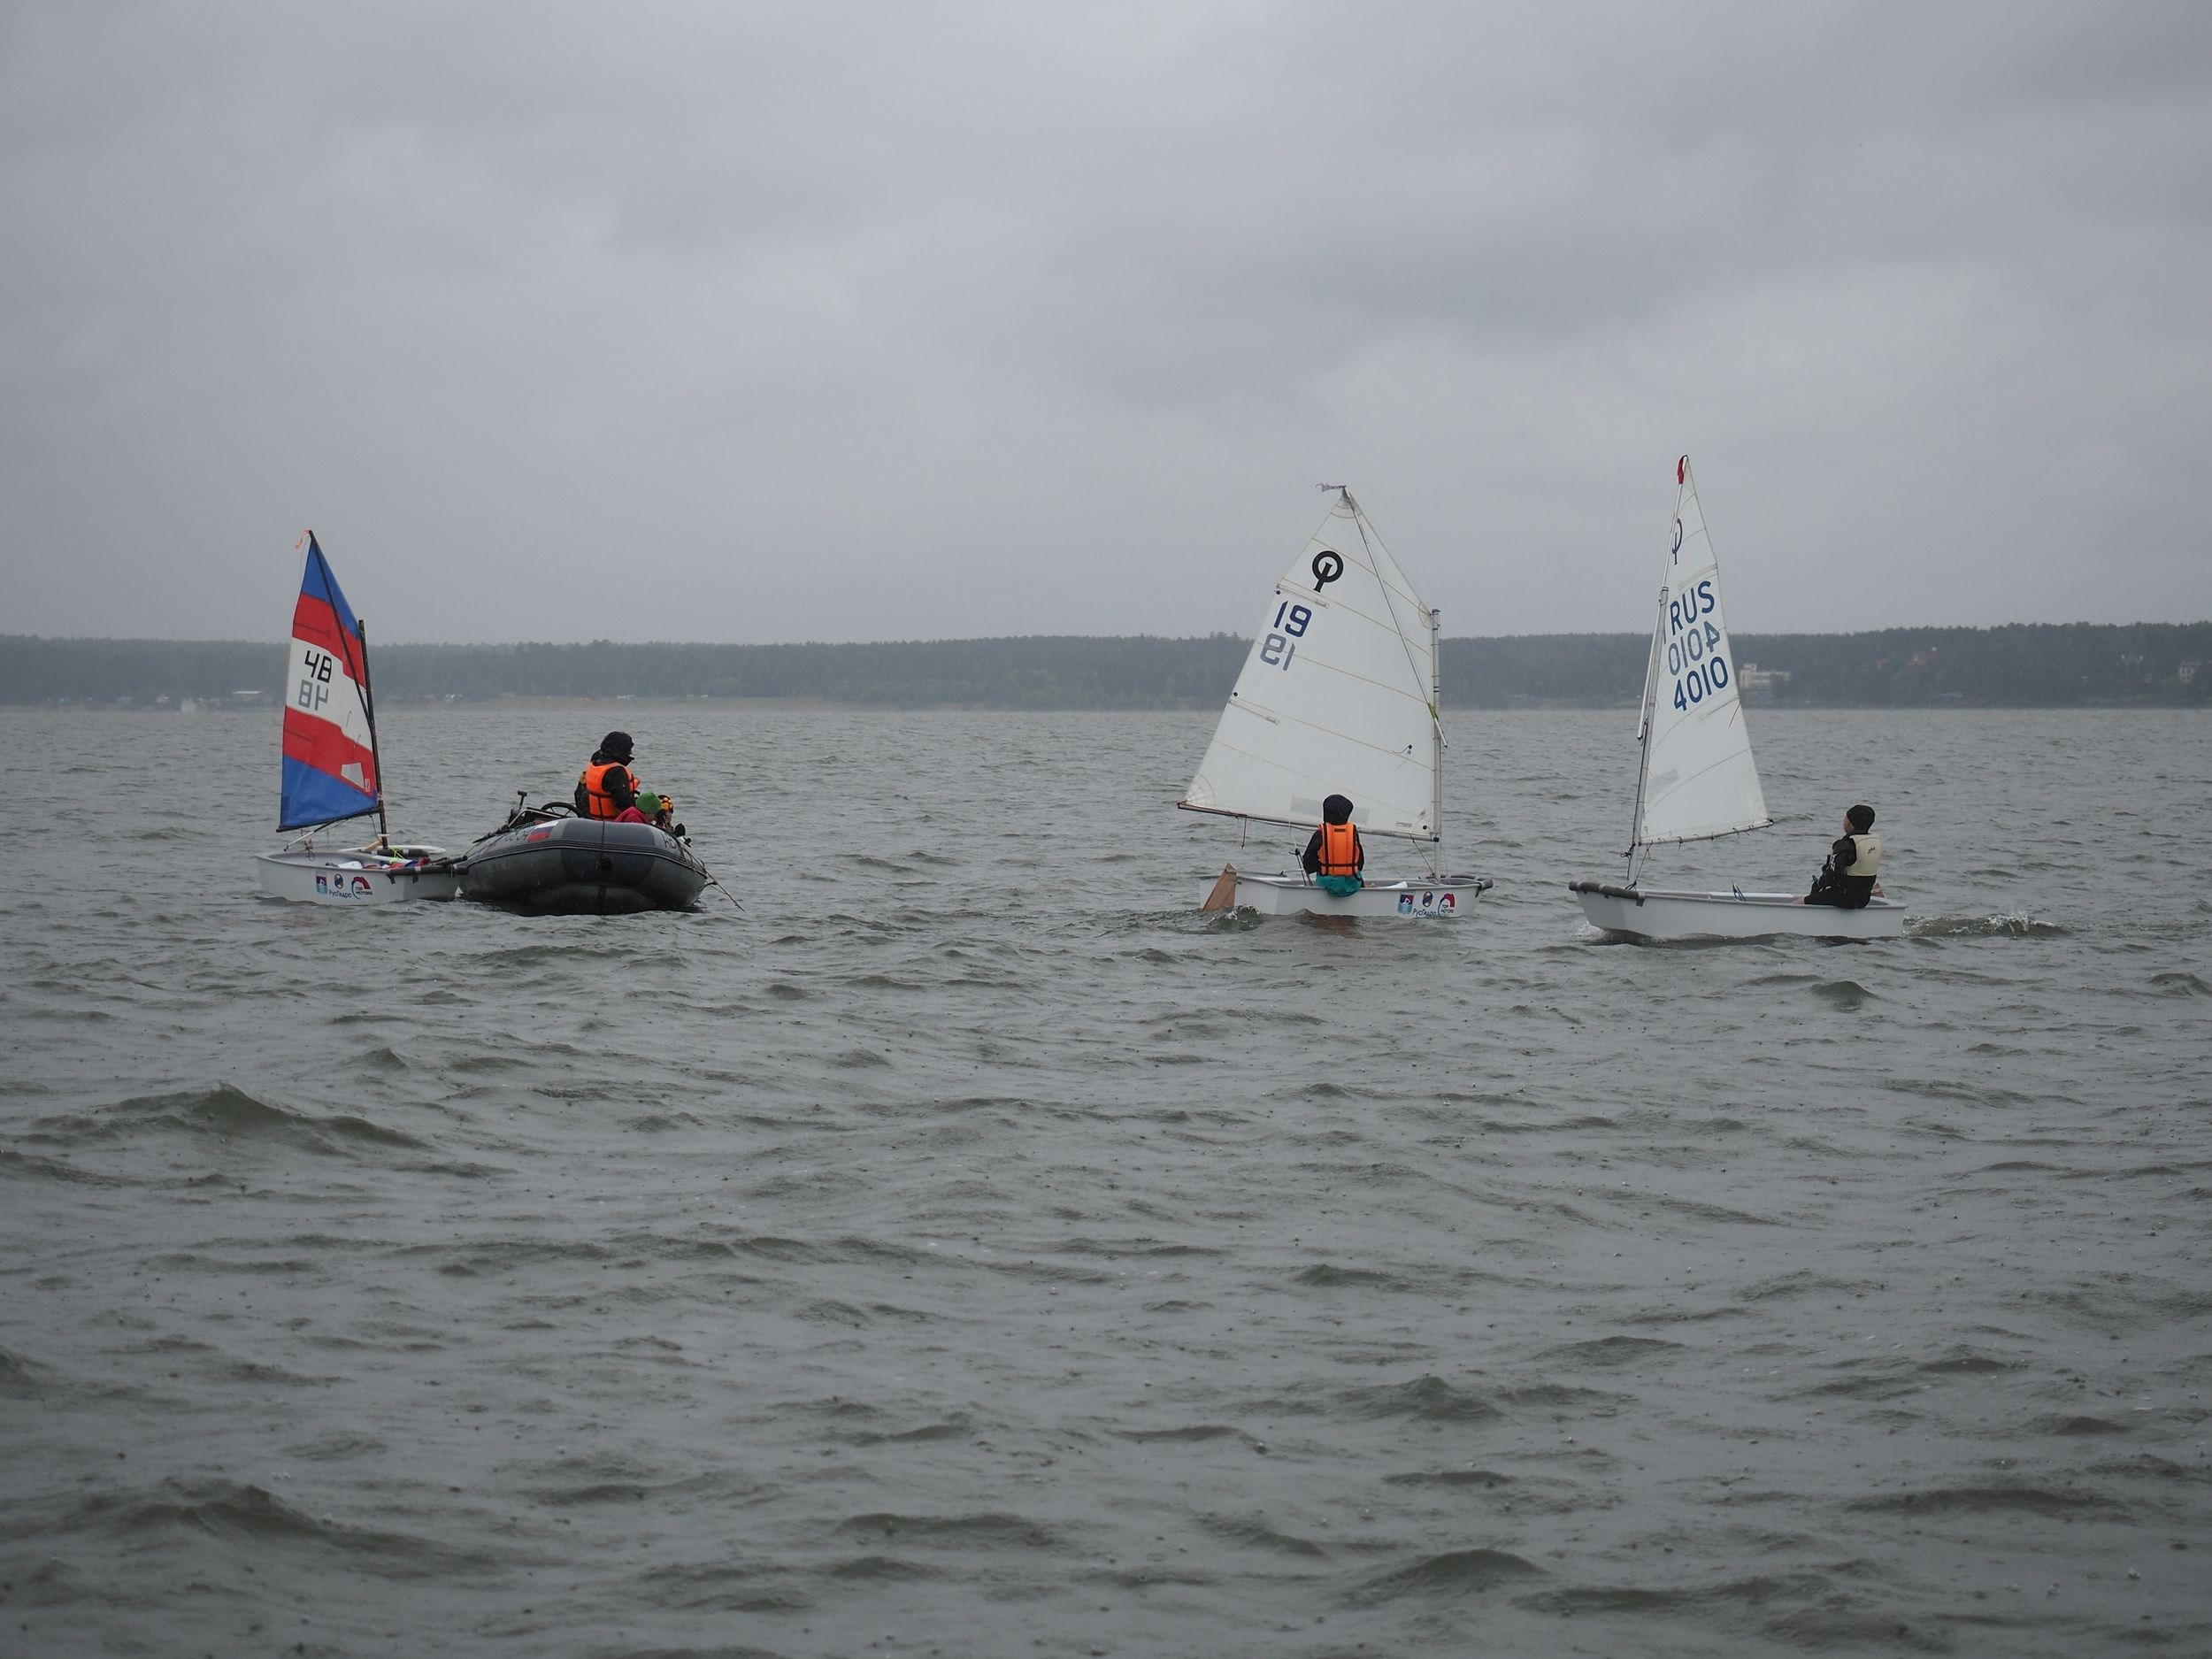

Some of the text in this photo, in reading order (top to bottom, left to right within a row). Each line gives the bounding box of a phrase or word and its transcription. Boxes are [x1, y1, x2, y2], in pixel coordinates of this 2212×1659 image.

[1273, 600, 1312, 638] 19
[1669, 580, 1716, 636] RUS
[1673, 656, 1729, 711] 4010
